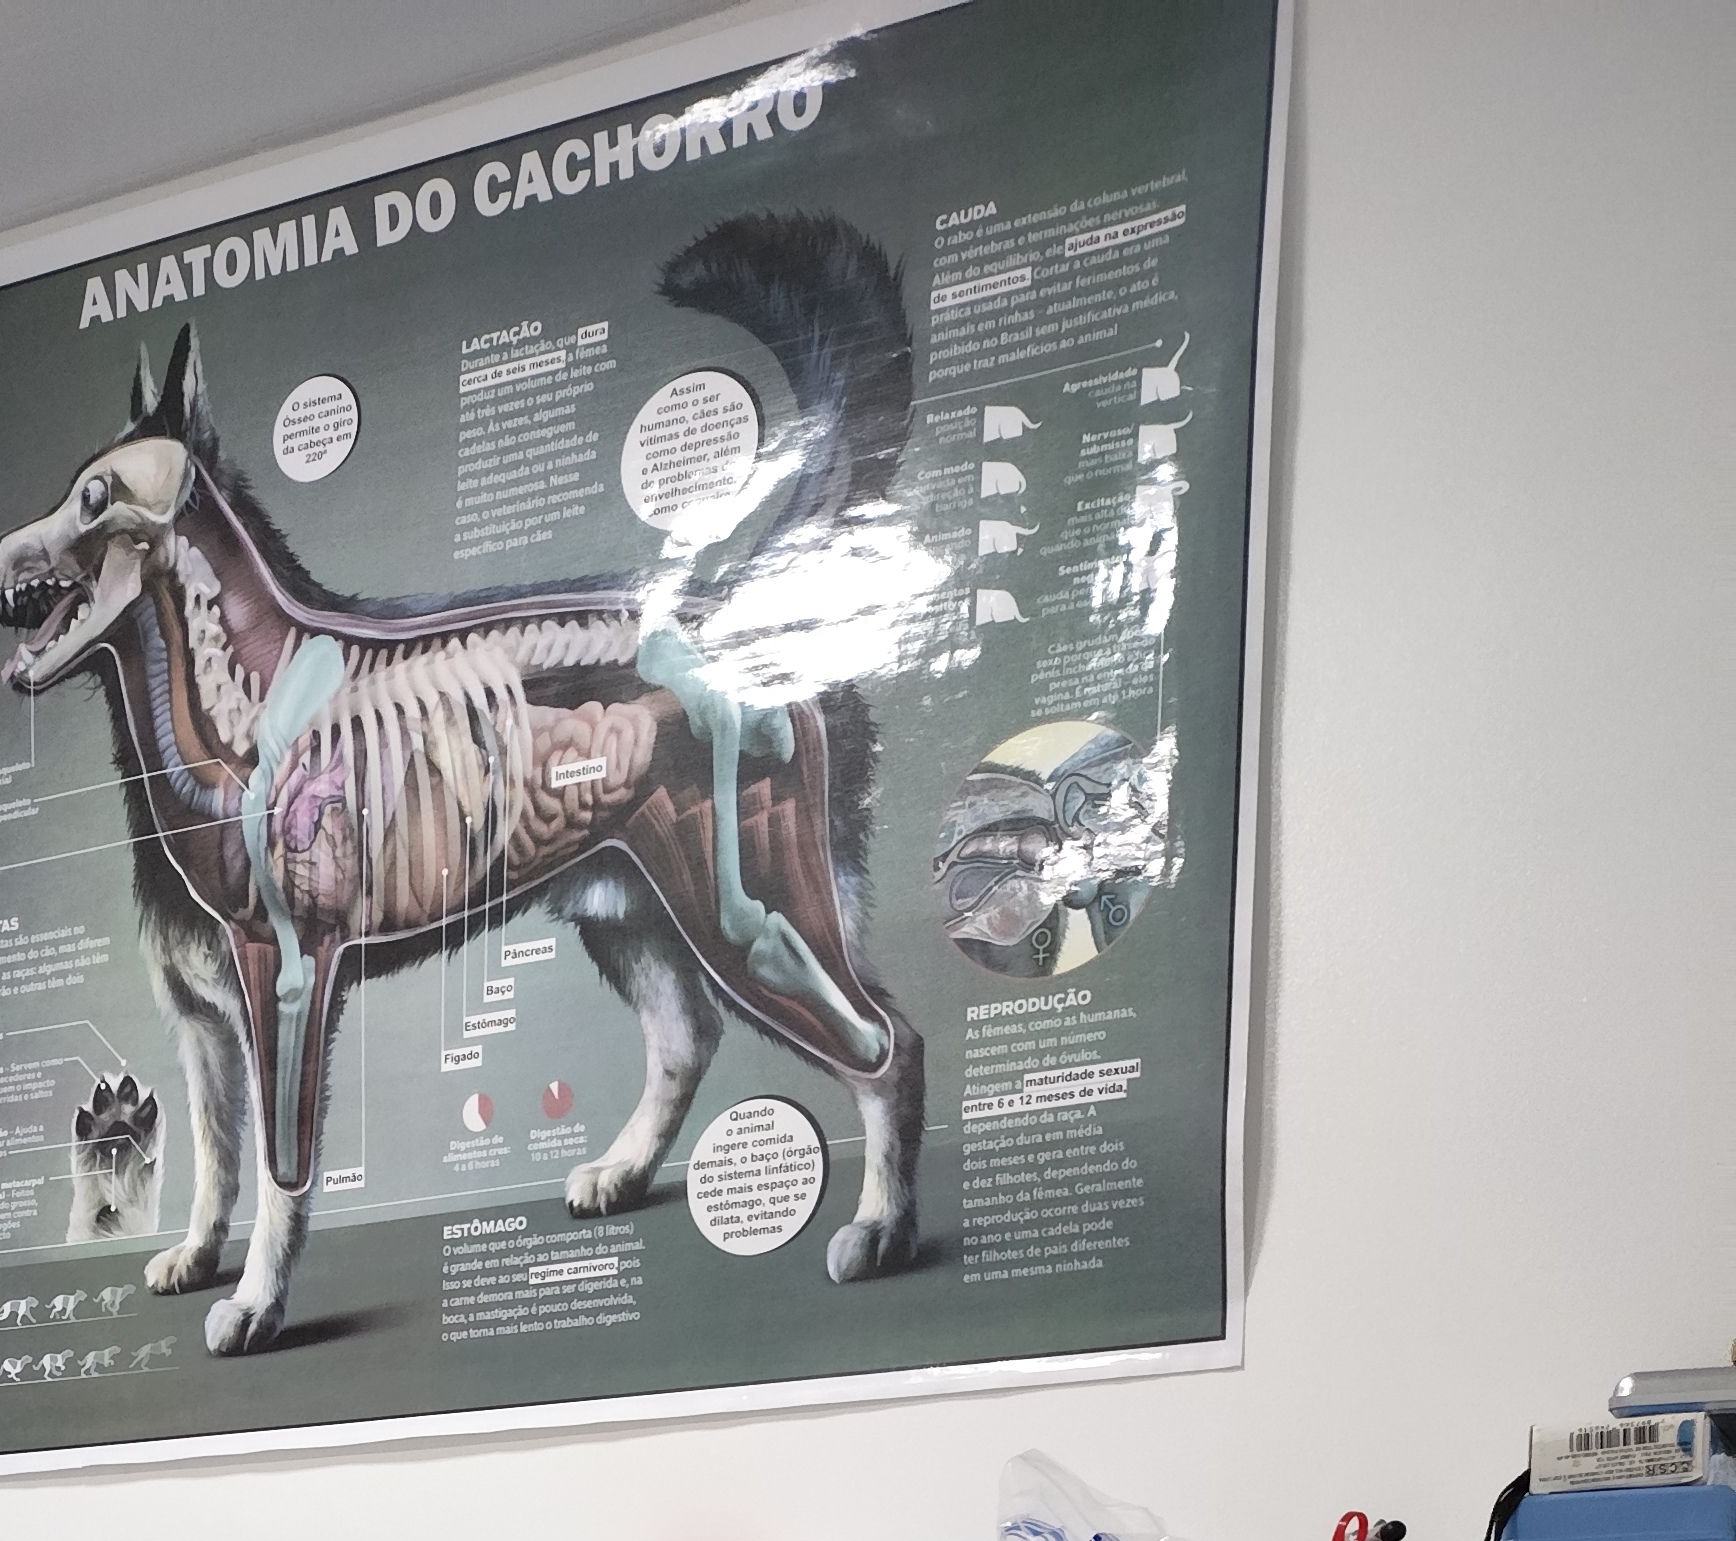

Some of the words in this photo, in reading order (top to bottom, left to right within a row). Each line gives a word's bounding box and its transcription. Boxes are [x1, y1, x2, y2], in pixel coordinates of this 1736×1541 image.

[77, 204, 359, 330] ANATOMIA
[376, 176, 457, 248] DO
[473, 72, 823, 217] CACHORRO
[936, 200, 997, 231] CAUDA
[1067, 232, 1100, 252] ajuda
[1104, 230, 1119, 242] na
[1122, 208, 1186, 238] expressão
[933, 292, 947, 304] de
[951, 274, 1030, 300] sentimentos.
[462, 320, 542, 355] LACTAÇÃO
[580, 326, 606, 340] dura
[461, 372, 488, 387] cerca
[491, 368, 503, 380] de
[505, 362, 526, 375] seis
[292, 401, 300, 412] O
[303, 393, 342, 409] sistema
[283, 415, 315, 428] Ósseo
[318, 404, 352, 419] canino
[283, 426, 320, 444] permite
[333, 418, 353, 431] giro
[283, 445, 294, 455] da
[298, 436, 333, 451] cabeça
[336, 432, 352, 442] em
[555, 762, 603, 782] Intestino
[504, 943, 554, 961] Pâncreas
[486, 982, 513, 997] Baço
[966, 988, 1092, 1022] REPRODUÇÃO
[464, 1014, 516, 1033] Estômago
[1025, 1068, 1095, 1088] maturidade
[1098, 1062, 1140, 1078] sexual
[963, 1100, 994, 1114] entre
[997, 1098, 1004, 1110] 6
[1008, 1098, 1014, 1108] e
[1019, 1094, 1032, 1106] 12
[1035, 1090, 1075, 1104] meses
[1079, 1086, 1094, 1098] de
[730, 1106, 775, 1121] Quando
[736, 1120, 775, 1135] animal
[713, 1141, 748, 1154] ingere
[752, 1133, 794, 1149] comida
[693, 1156, 736, 1171] demais,
[741, 1156, 747, 1164] o
[751, 1151, 779, 1165] baço
[783, 1146, 820, 1160] (órgão
[325, 1172, 363, 1187] Pulmão
[700, 1174, 714, 1184] do
[718, 1168, 761, 1182] sistema
[765, 1159, 815, 1176] linfático)
[696, 1188, 723, 1199] cede
[727, 1184, 753, 1195] mais
[757, 1178, 798, 1193] espaço
[802, 1176, 815, 1185] ao
[769, 1193, 790, 1206] que
[794, 1192, 807, 1201] se
[443, 1214, 528, 1241] ESTÔMAGO
[710, 1215, 743, 1227] dilata,
[747, 1207, 796, 1222] evitando
[723, 1224, 783, 1242] problemas
[530, 1265, 565, 1282] regime
